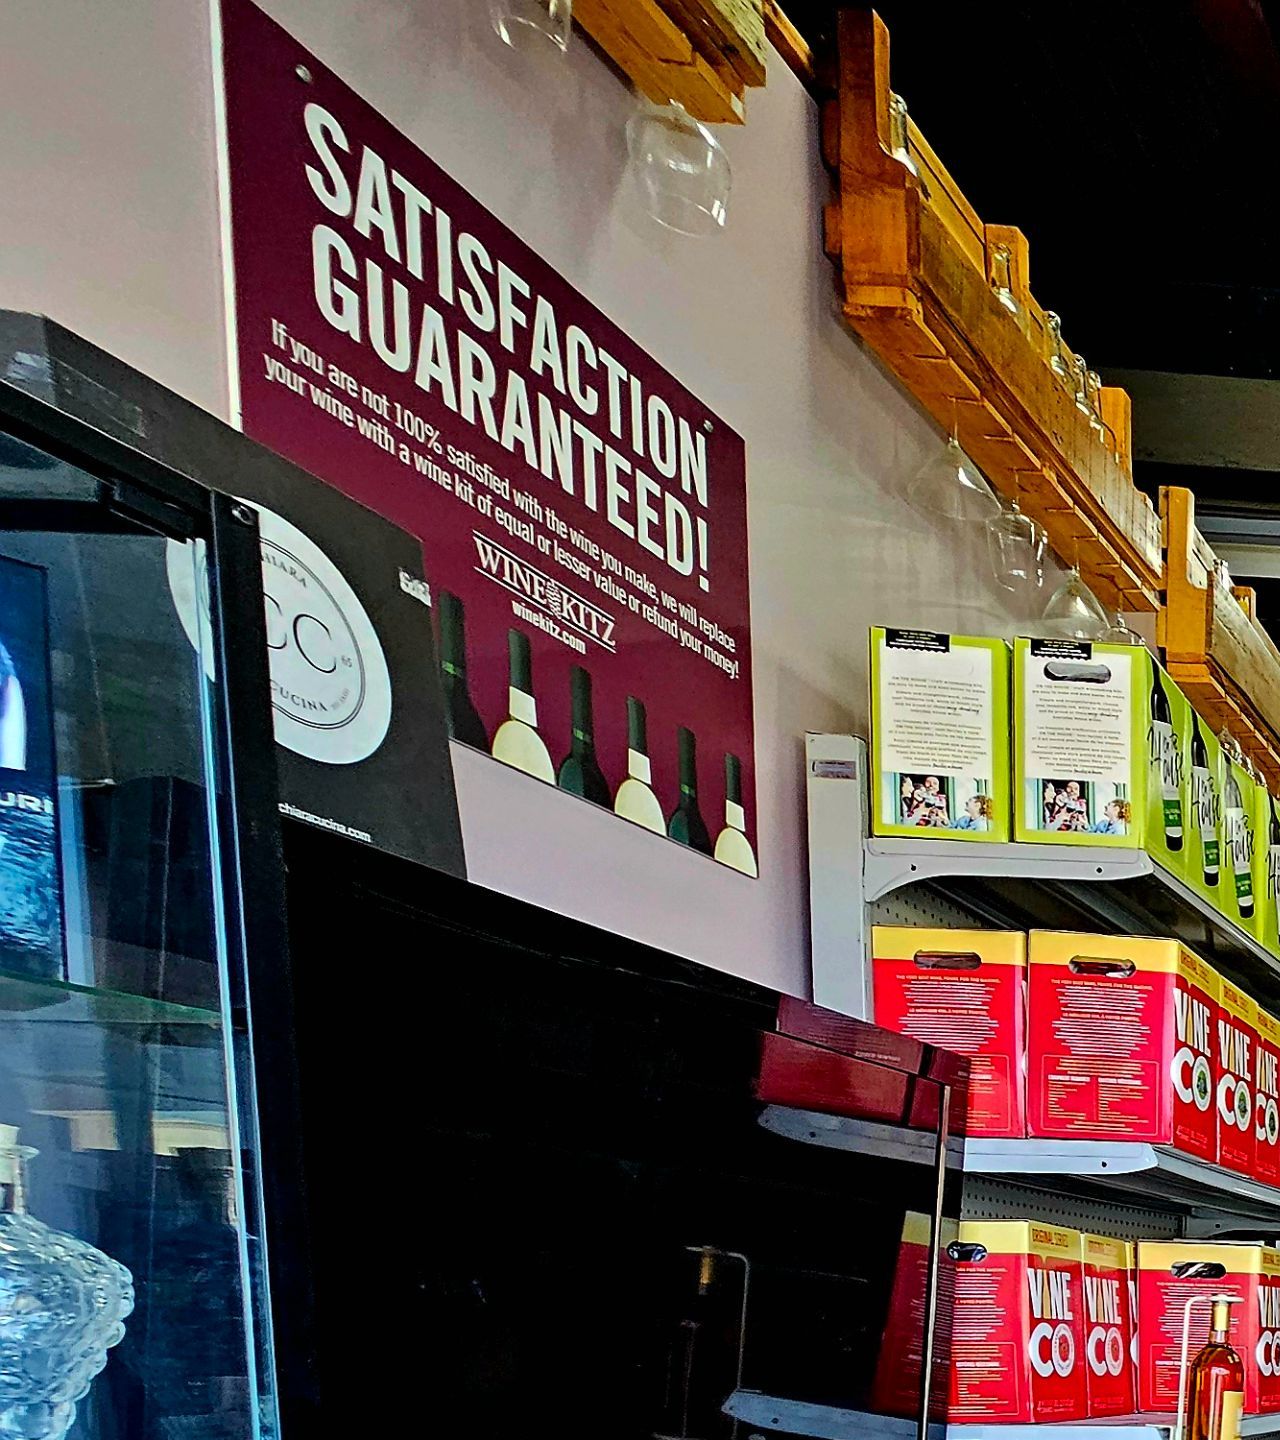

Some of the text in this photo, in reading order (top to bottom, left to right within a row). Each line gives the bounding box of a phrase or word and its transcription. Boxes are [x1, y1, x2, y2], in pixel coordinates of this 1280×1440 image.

[304, 103, 709, 507] SATISFACTION
[312, 223, 711, 592] GUARANTEED!
[263, 353, 740, 680] your wine with a wine kit of equal or lesser value or refund your money!
[271, 318, 736, 653] If you are not 100% satisfied with the wine you make, we will replace
[473, 536, 548, 607] WINE
[559, 594, 617, 647] KITZ
[511, 600, 587, 655] winekitz.com
[1172, 987, 1212, 1057] VINE
[1218, 1019, 1251, 1081] VINE
[1170, 1047, 1212, 1111] CO
[1217, 1073, 1251, 1132] CO
[1257, 1047, 1279, 1099] VINE
[1027, 1267, 1073, 1320] VINE
[1085, 1276, 1122, 1324] VINE
[1028, 1322, 1075, 1378] CO
[1087, 1325, 1124, 1377] CO
